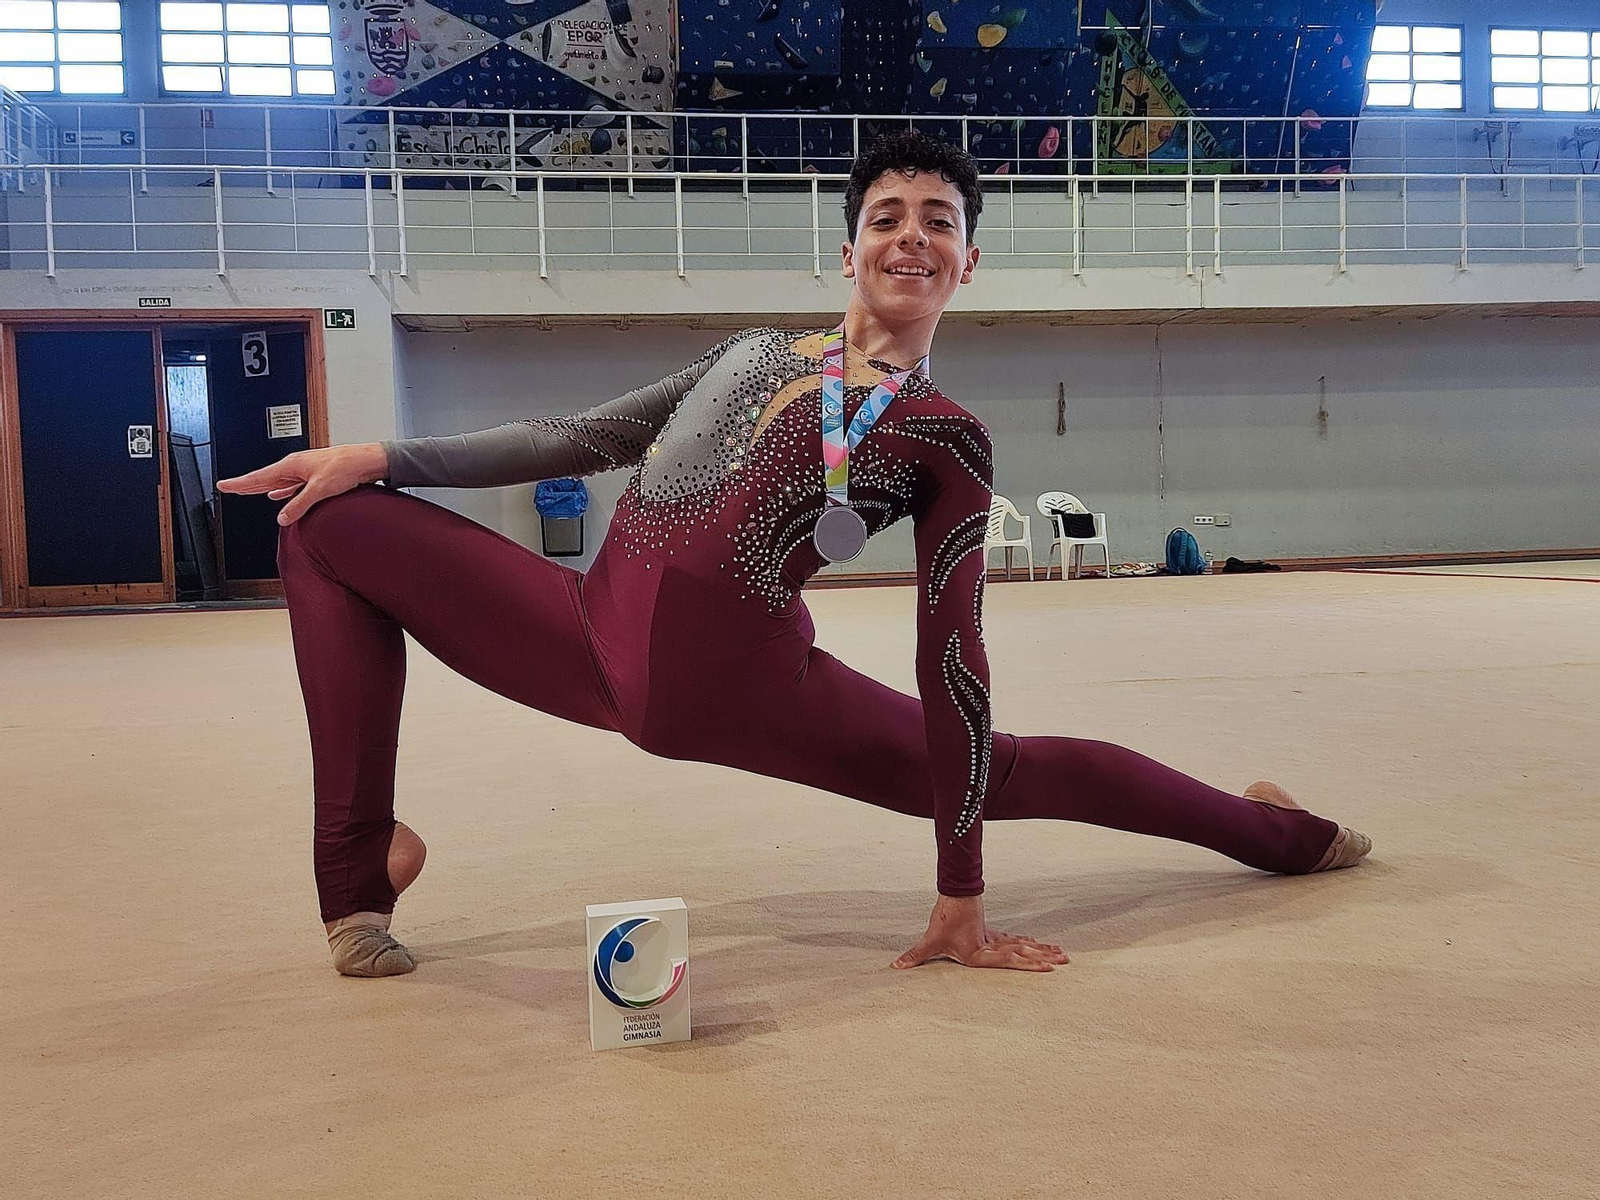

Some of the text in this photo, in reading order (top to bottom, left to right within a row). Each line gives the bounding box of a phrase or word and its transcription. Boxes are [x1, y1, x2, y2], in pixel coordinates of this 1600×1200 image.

[140, 299, 170, 307] SALIDA
[244, 340, 267, 374] 3
[623, 1012, 660, 1023] FEDERACIÓN
[623, 1022, 661, 1032] ANDALUZA
[623, 1030, 662, 1041] GIMNASIA
